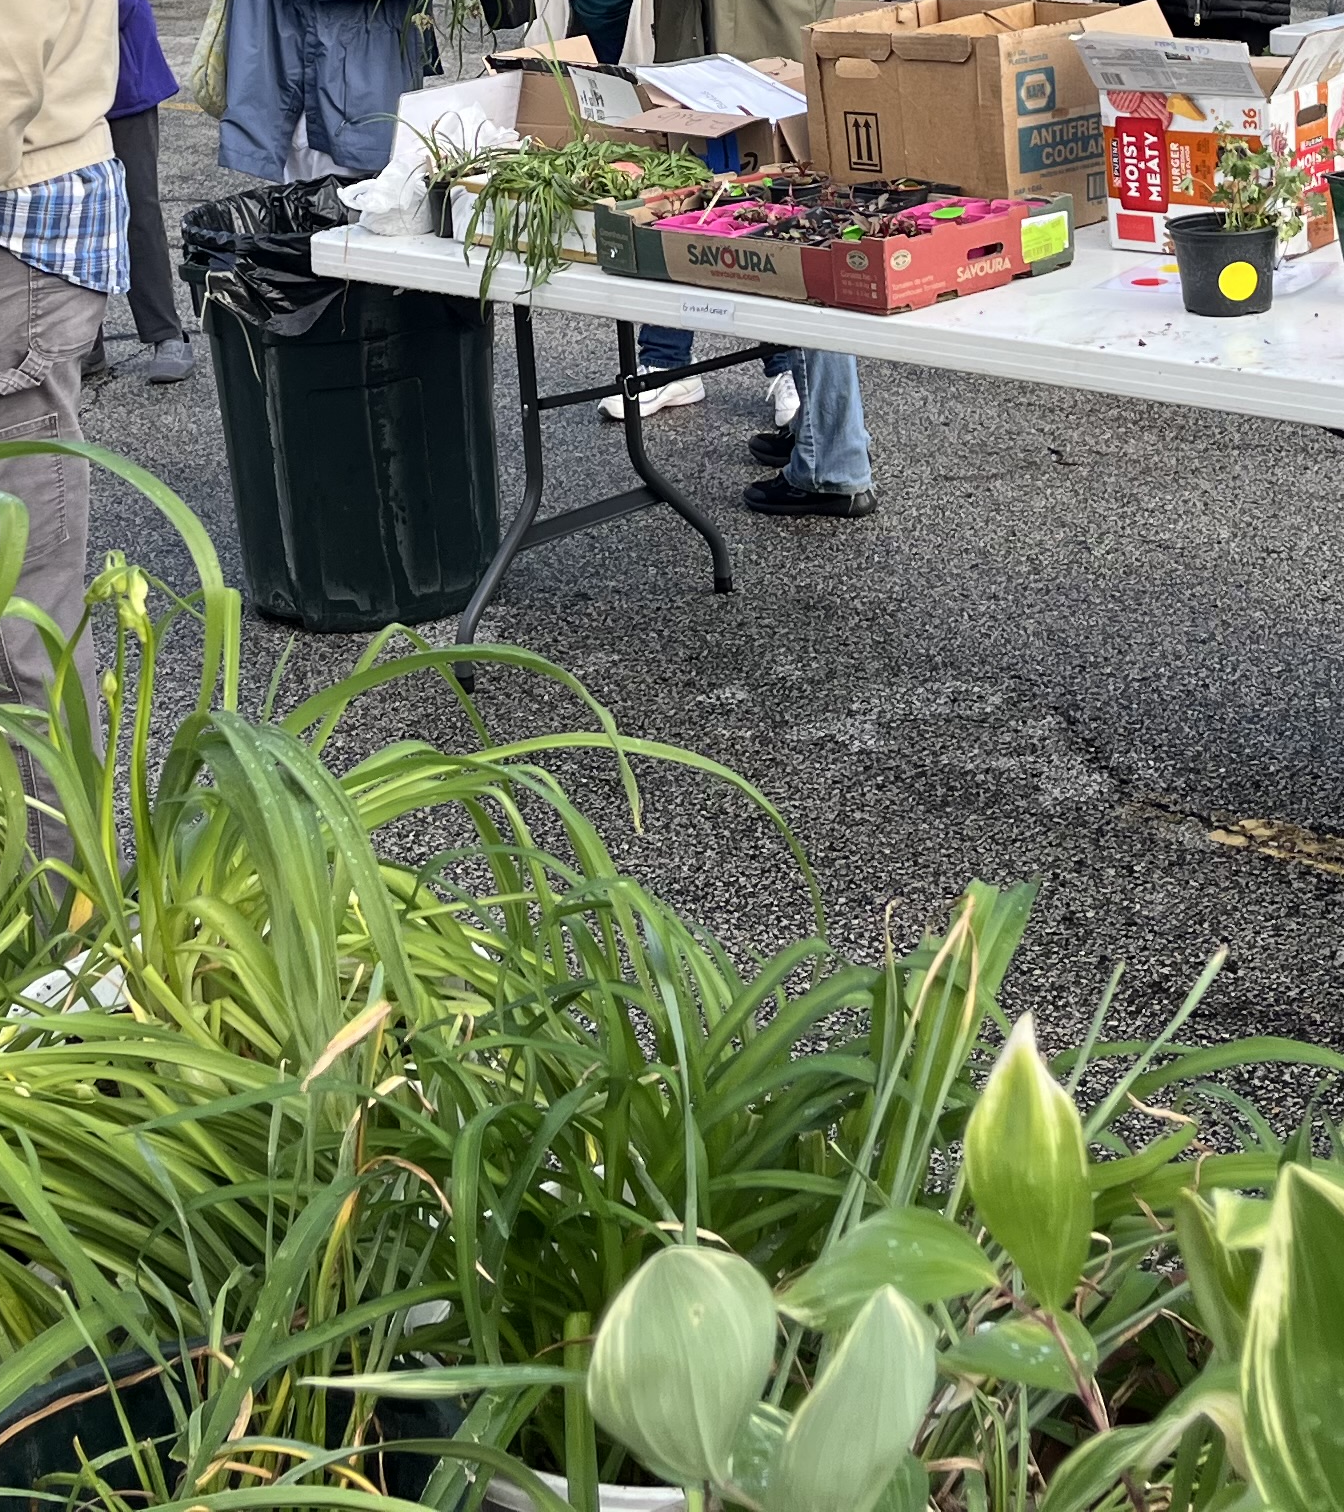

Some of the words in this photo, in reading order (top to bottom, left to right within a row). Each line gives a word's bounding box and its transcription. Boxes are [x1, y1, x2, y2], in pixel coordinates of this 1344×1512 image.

[1029, 117, 1102, 148] ANTIFRE
[1243, 107, 1257, 130] 36
[1112, 140, 1120, 178] PURINA
[1122, 132, 1141, 198] MOIST
[1137, 160, 1146, 170] &
[1143, 131, 1163, 202] MEATY
[1297, 150, 1326, 170] MOIS
[687, 243, 777, 275] SAVOURA
[956, 256, 1012, 283] SAVOURA
